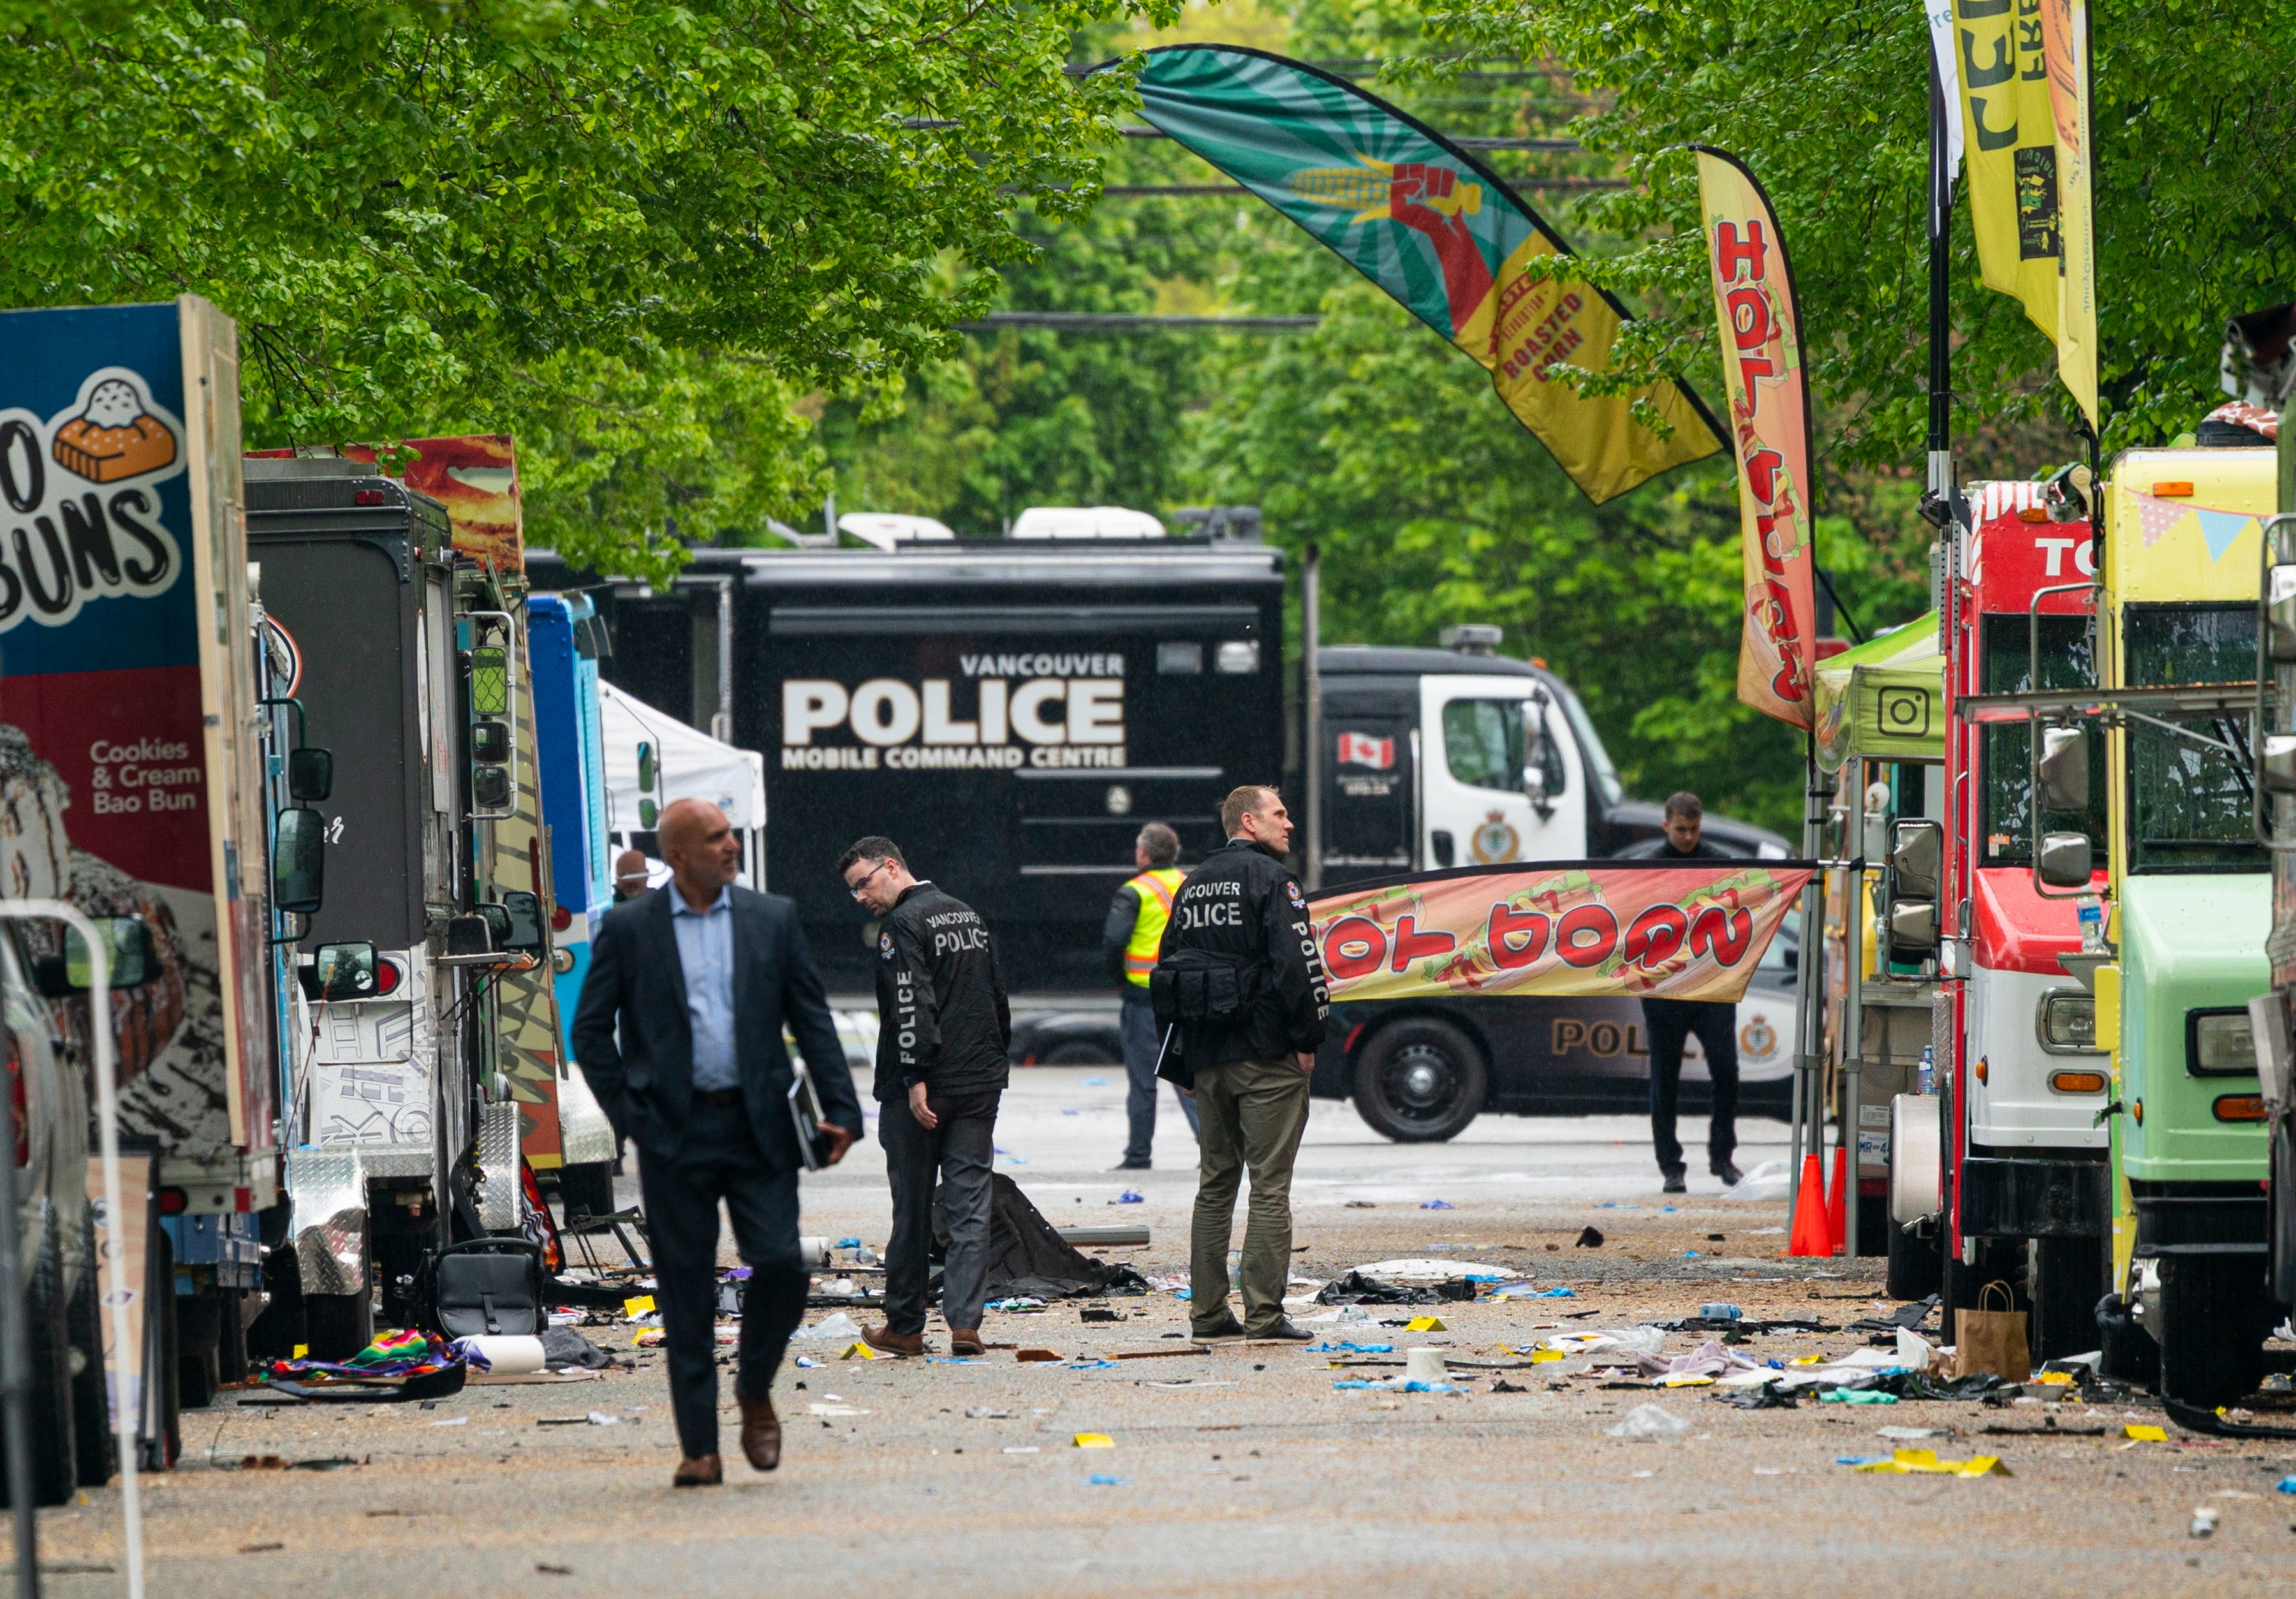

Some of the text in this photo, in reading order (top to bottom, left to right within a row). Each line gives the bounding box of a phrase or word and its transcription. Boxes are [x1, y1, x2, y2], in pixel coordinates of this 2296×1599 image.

[1502, 293, 1584, 379] ROASTED
[1532, 327, 1584, 383] CORN
[960, 654, 1124, 676] VANCOUVER
[783, 679, 1125, 745] POLICE
[89, 737, 189, 764] Cookies
[781, 746, 1127, 769] MOBILE COMMAND CENTRE
[92, 764, 201, 790] & Cream
[93, 788, 196, 814] Bao Bun
[1292, 921, 1330, 1021] POLICE
[897, 970, 916, 1065] POLICE
